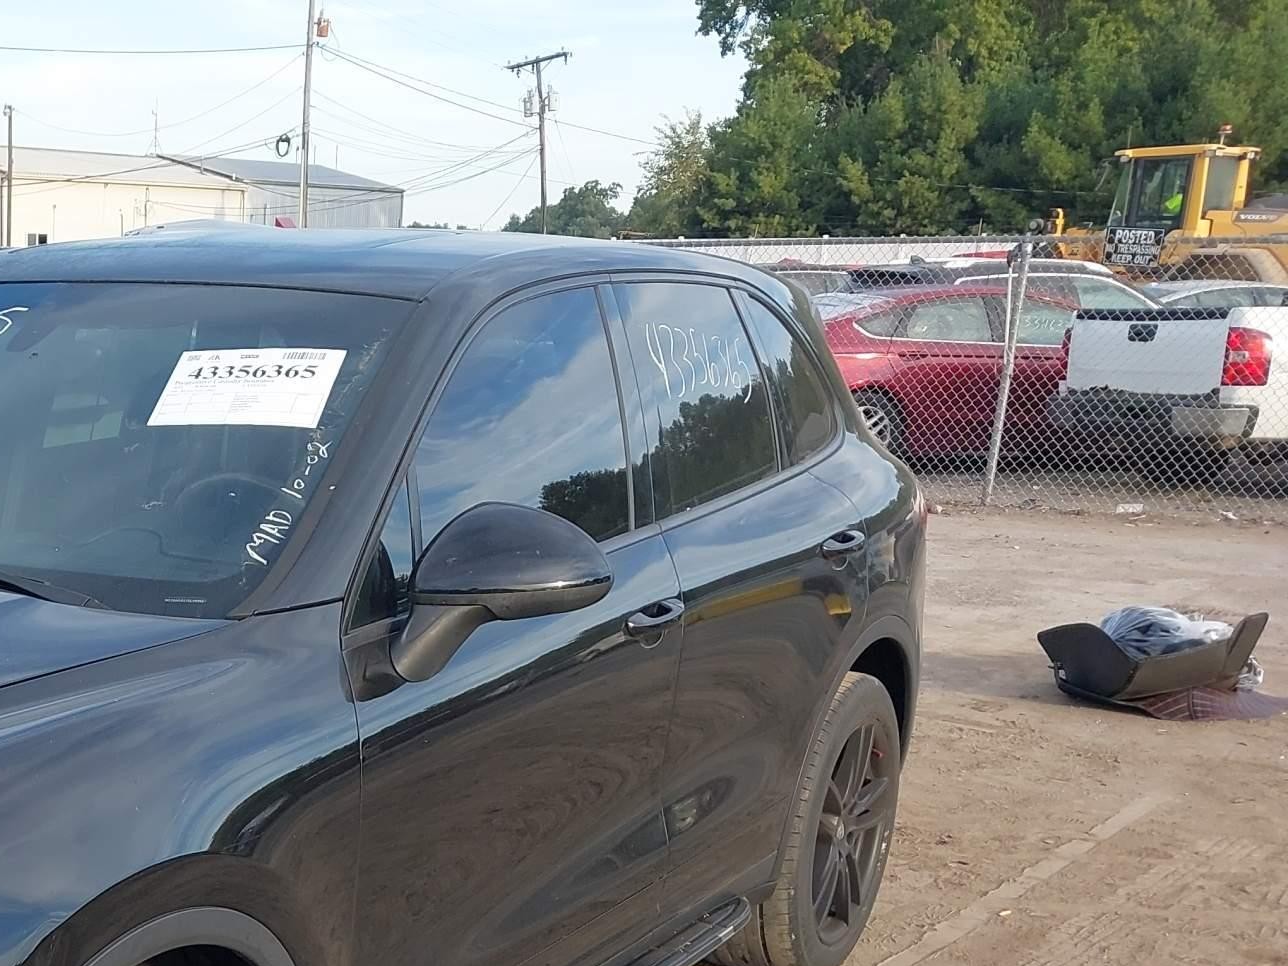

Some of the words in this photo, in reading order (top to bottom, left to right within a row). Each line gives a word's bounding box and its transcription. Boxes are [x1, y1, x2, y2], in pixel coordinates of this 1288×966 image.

[1114, 229, 1155, 244] POSTED
[1116, 244, 1161, 254] TRESPASSING
[1112, 254, 1132, 263] KEEP
[1133, 255, 1152, 264] OUT
[187, 364, 319, 380] 43356365
